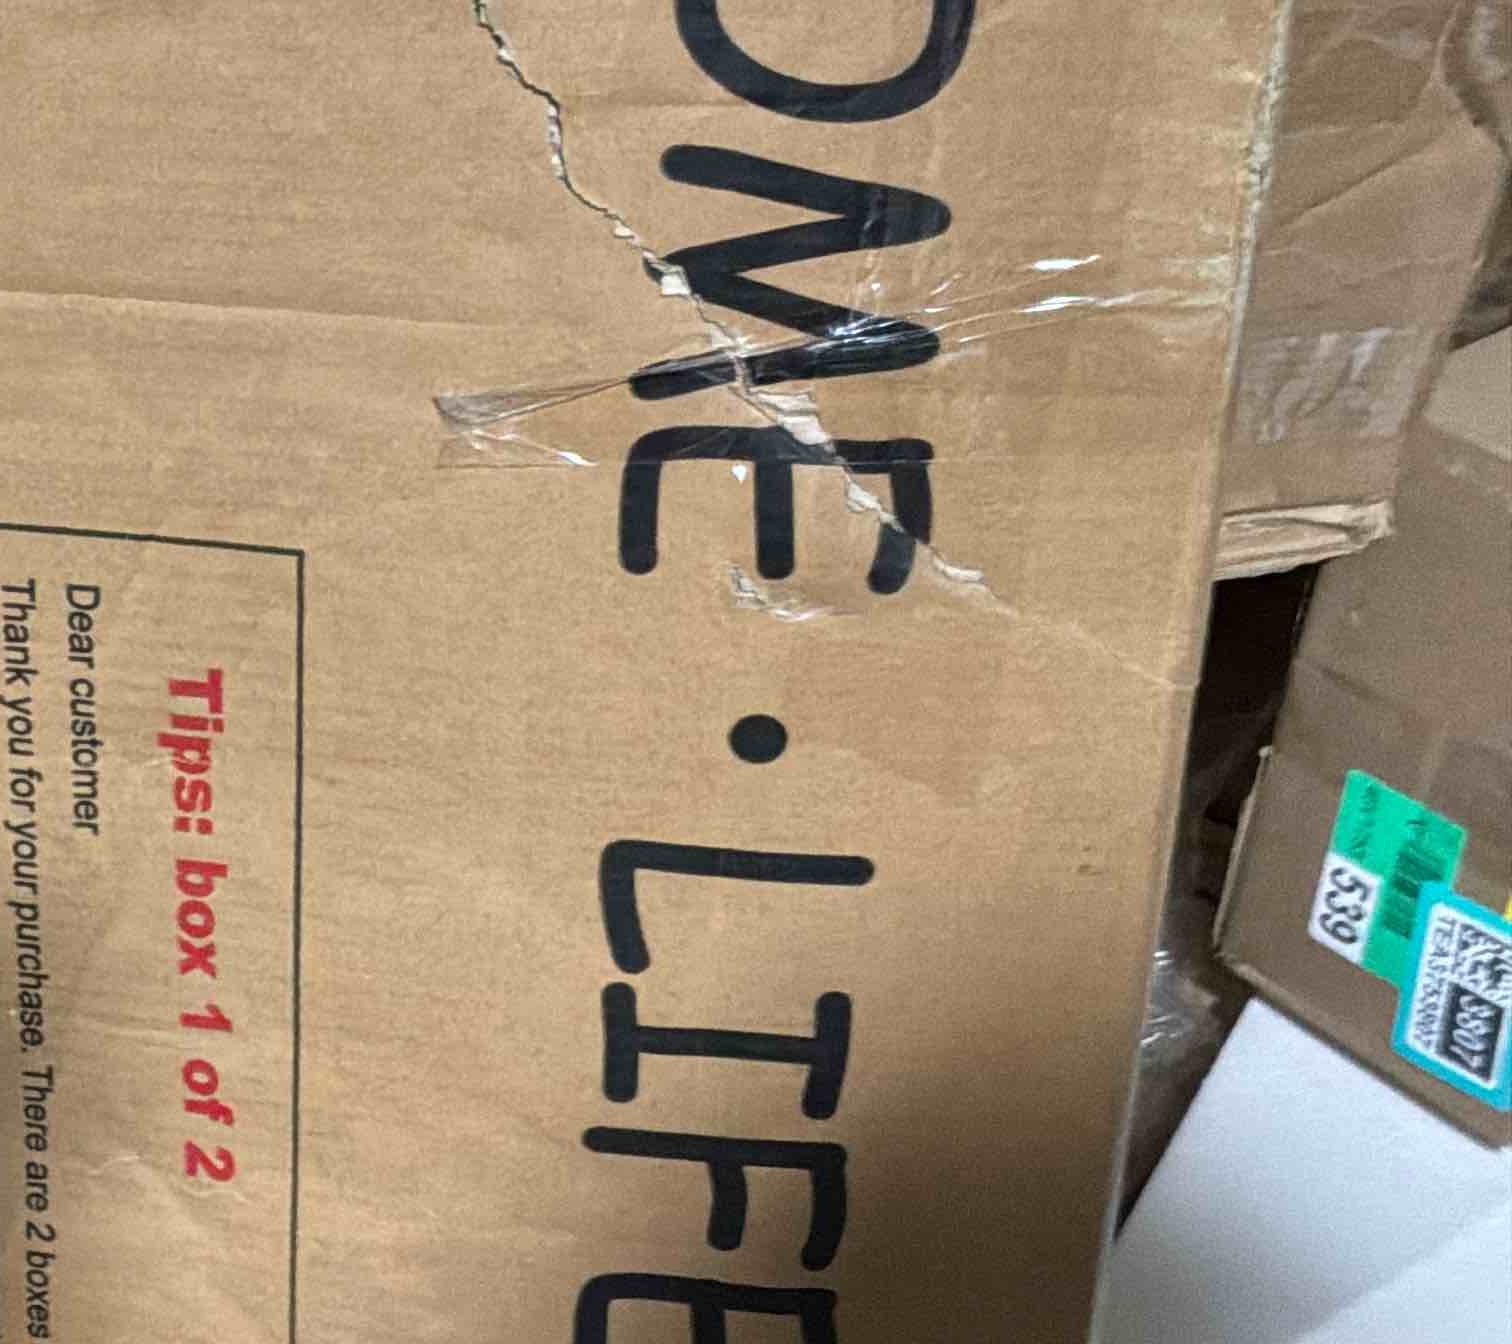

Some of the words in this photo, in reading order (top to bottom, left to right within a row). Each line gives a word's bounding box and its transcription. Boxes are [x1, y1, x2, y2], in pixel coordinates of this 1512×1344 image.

[1, 577, 39, 688] Thank
[64, 583, 102, 672] Dear
[8, 762, 44, 809] for
[69, 678, 104, 836] customer
[157, 667, 225, 835] Tips:
[4, 814, 40, 893] your
[172, 858, 229, 978] box
[1317, 863, 1374, 949] 539
[8, 898, 52, 1053] purchase.
[180, 1000, 233, 1033] 1
[19, 1066, 57, 1151] There
[182, 1058, 236, 1127] of
[27, 1156, 49, 1214] are
[184, 1140, 237, 1184] 2
[24, 1221, 57, 1242] 2
[25, 1250, 57, 1339] boxes
